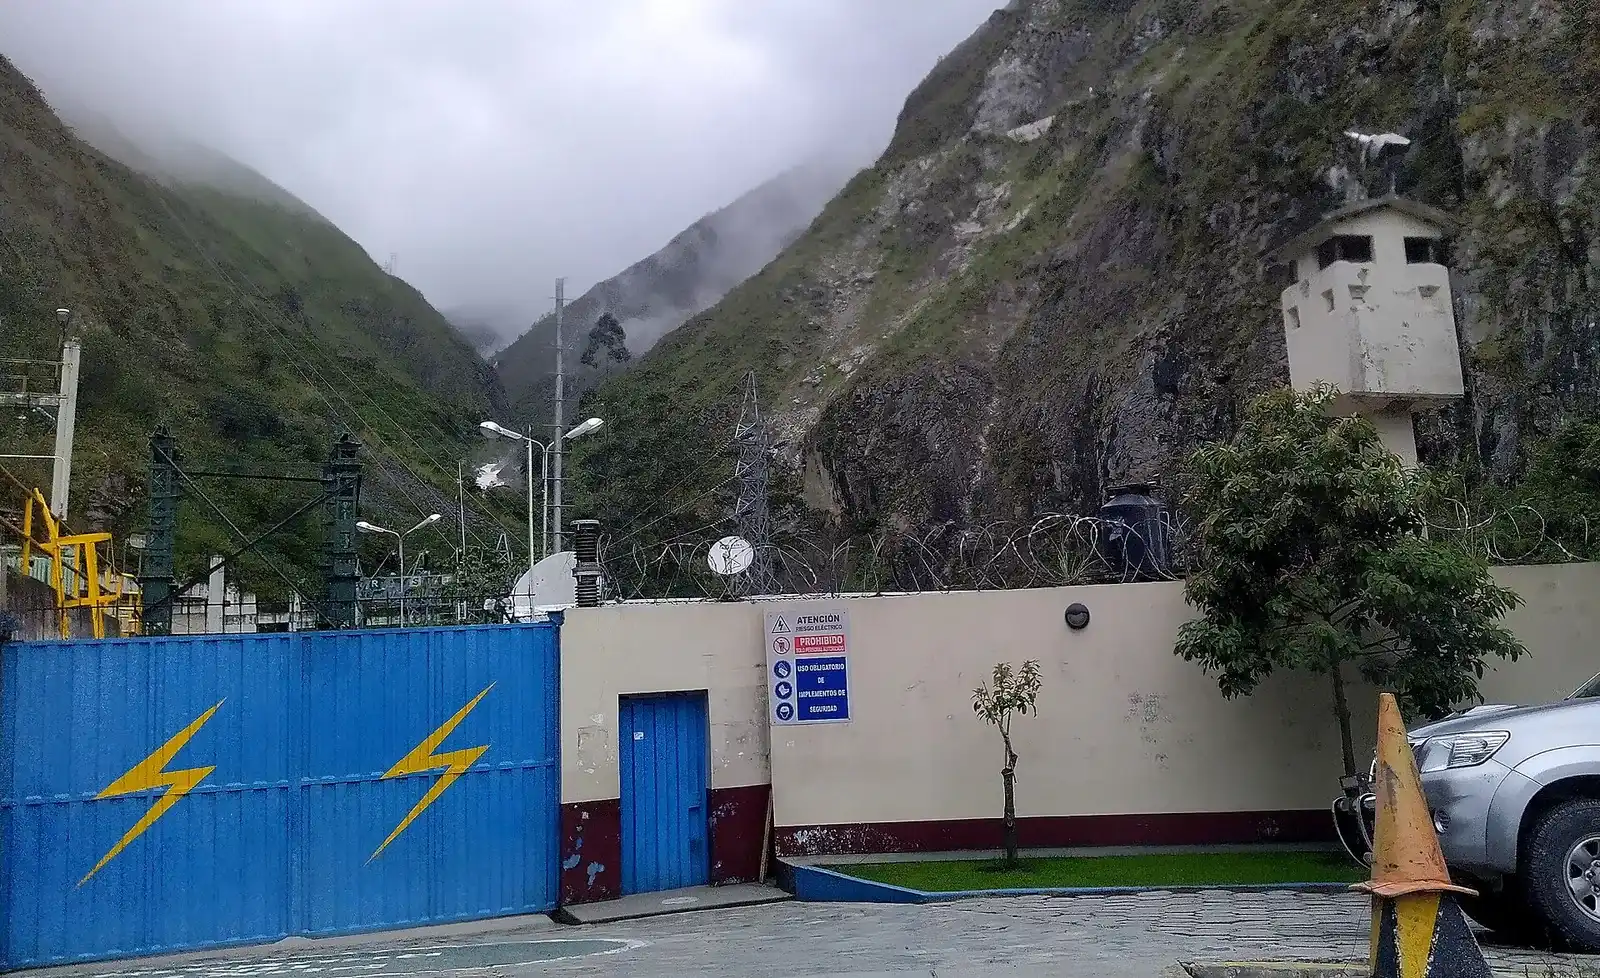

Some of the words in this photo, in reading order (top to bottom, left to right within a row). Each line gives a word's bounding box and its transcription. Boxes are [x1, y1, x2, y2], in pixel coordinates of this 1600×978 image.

[797, 614, 840, 624] ATENCIÓN
[815, 624, 843, 632] ELÉCTRICO
[800, 636, 843, 646] PROHIBIDO
[809, 663, 845, 671] OBLIGATORIO
[798, 690, 837, 698] IMPLEMENTOS
[809, 705, 838, 713] SEGURIDAD
